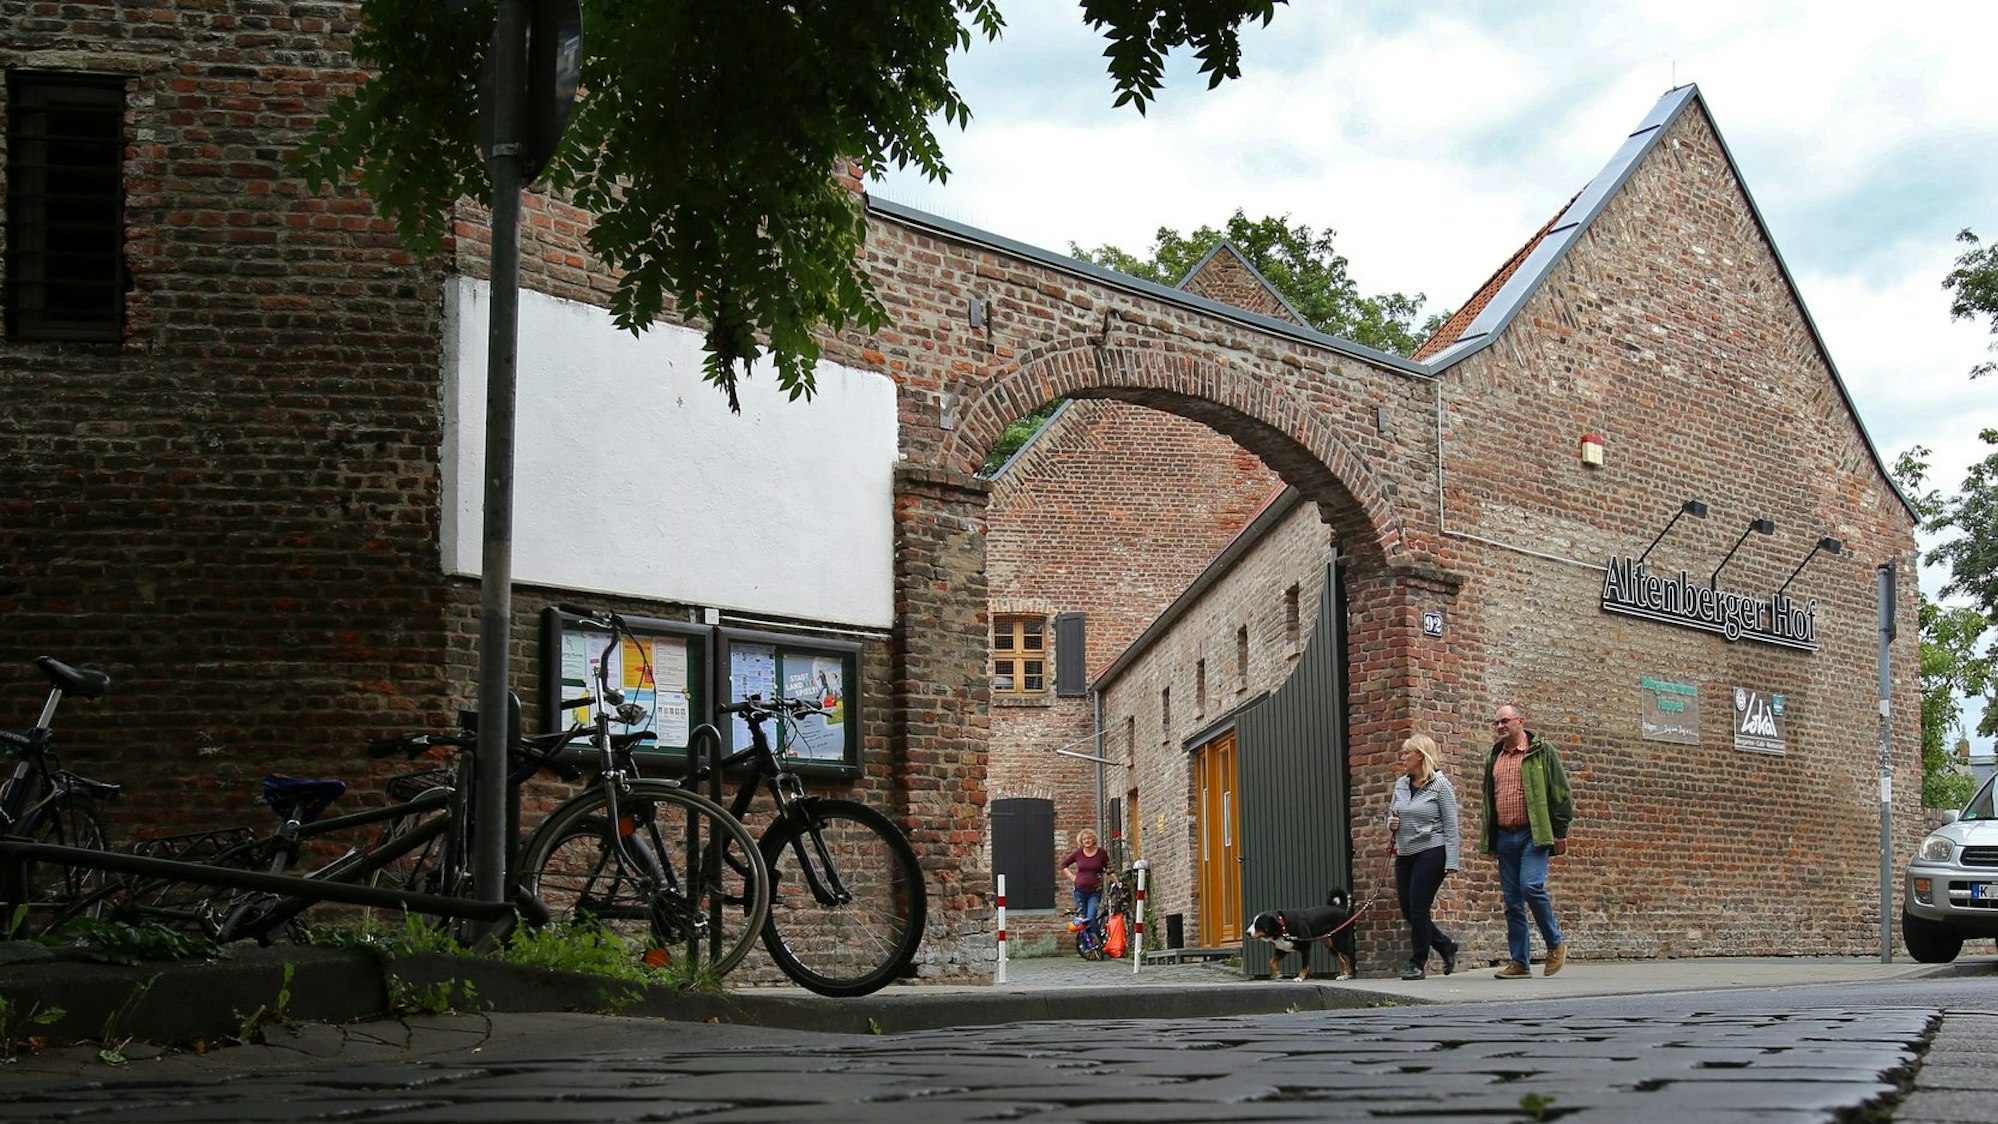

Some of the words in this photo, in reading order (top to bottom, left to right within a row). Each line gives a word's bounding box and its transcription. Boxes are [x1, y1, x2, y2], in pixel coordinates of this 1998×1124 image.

[1604, 556, 1766, 641] Altenberger
[1773, 594, 1817, 641] Hof
[1425, 615, 1441, 633] 92
[1981, 887, 1988, 897] K
